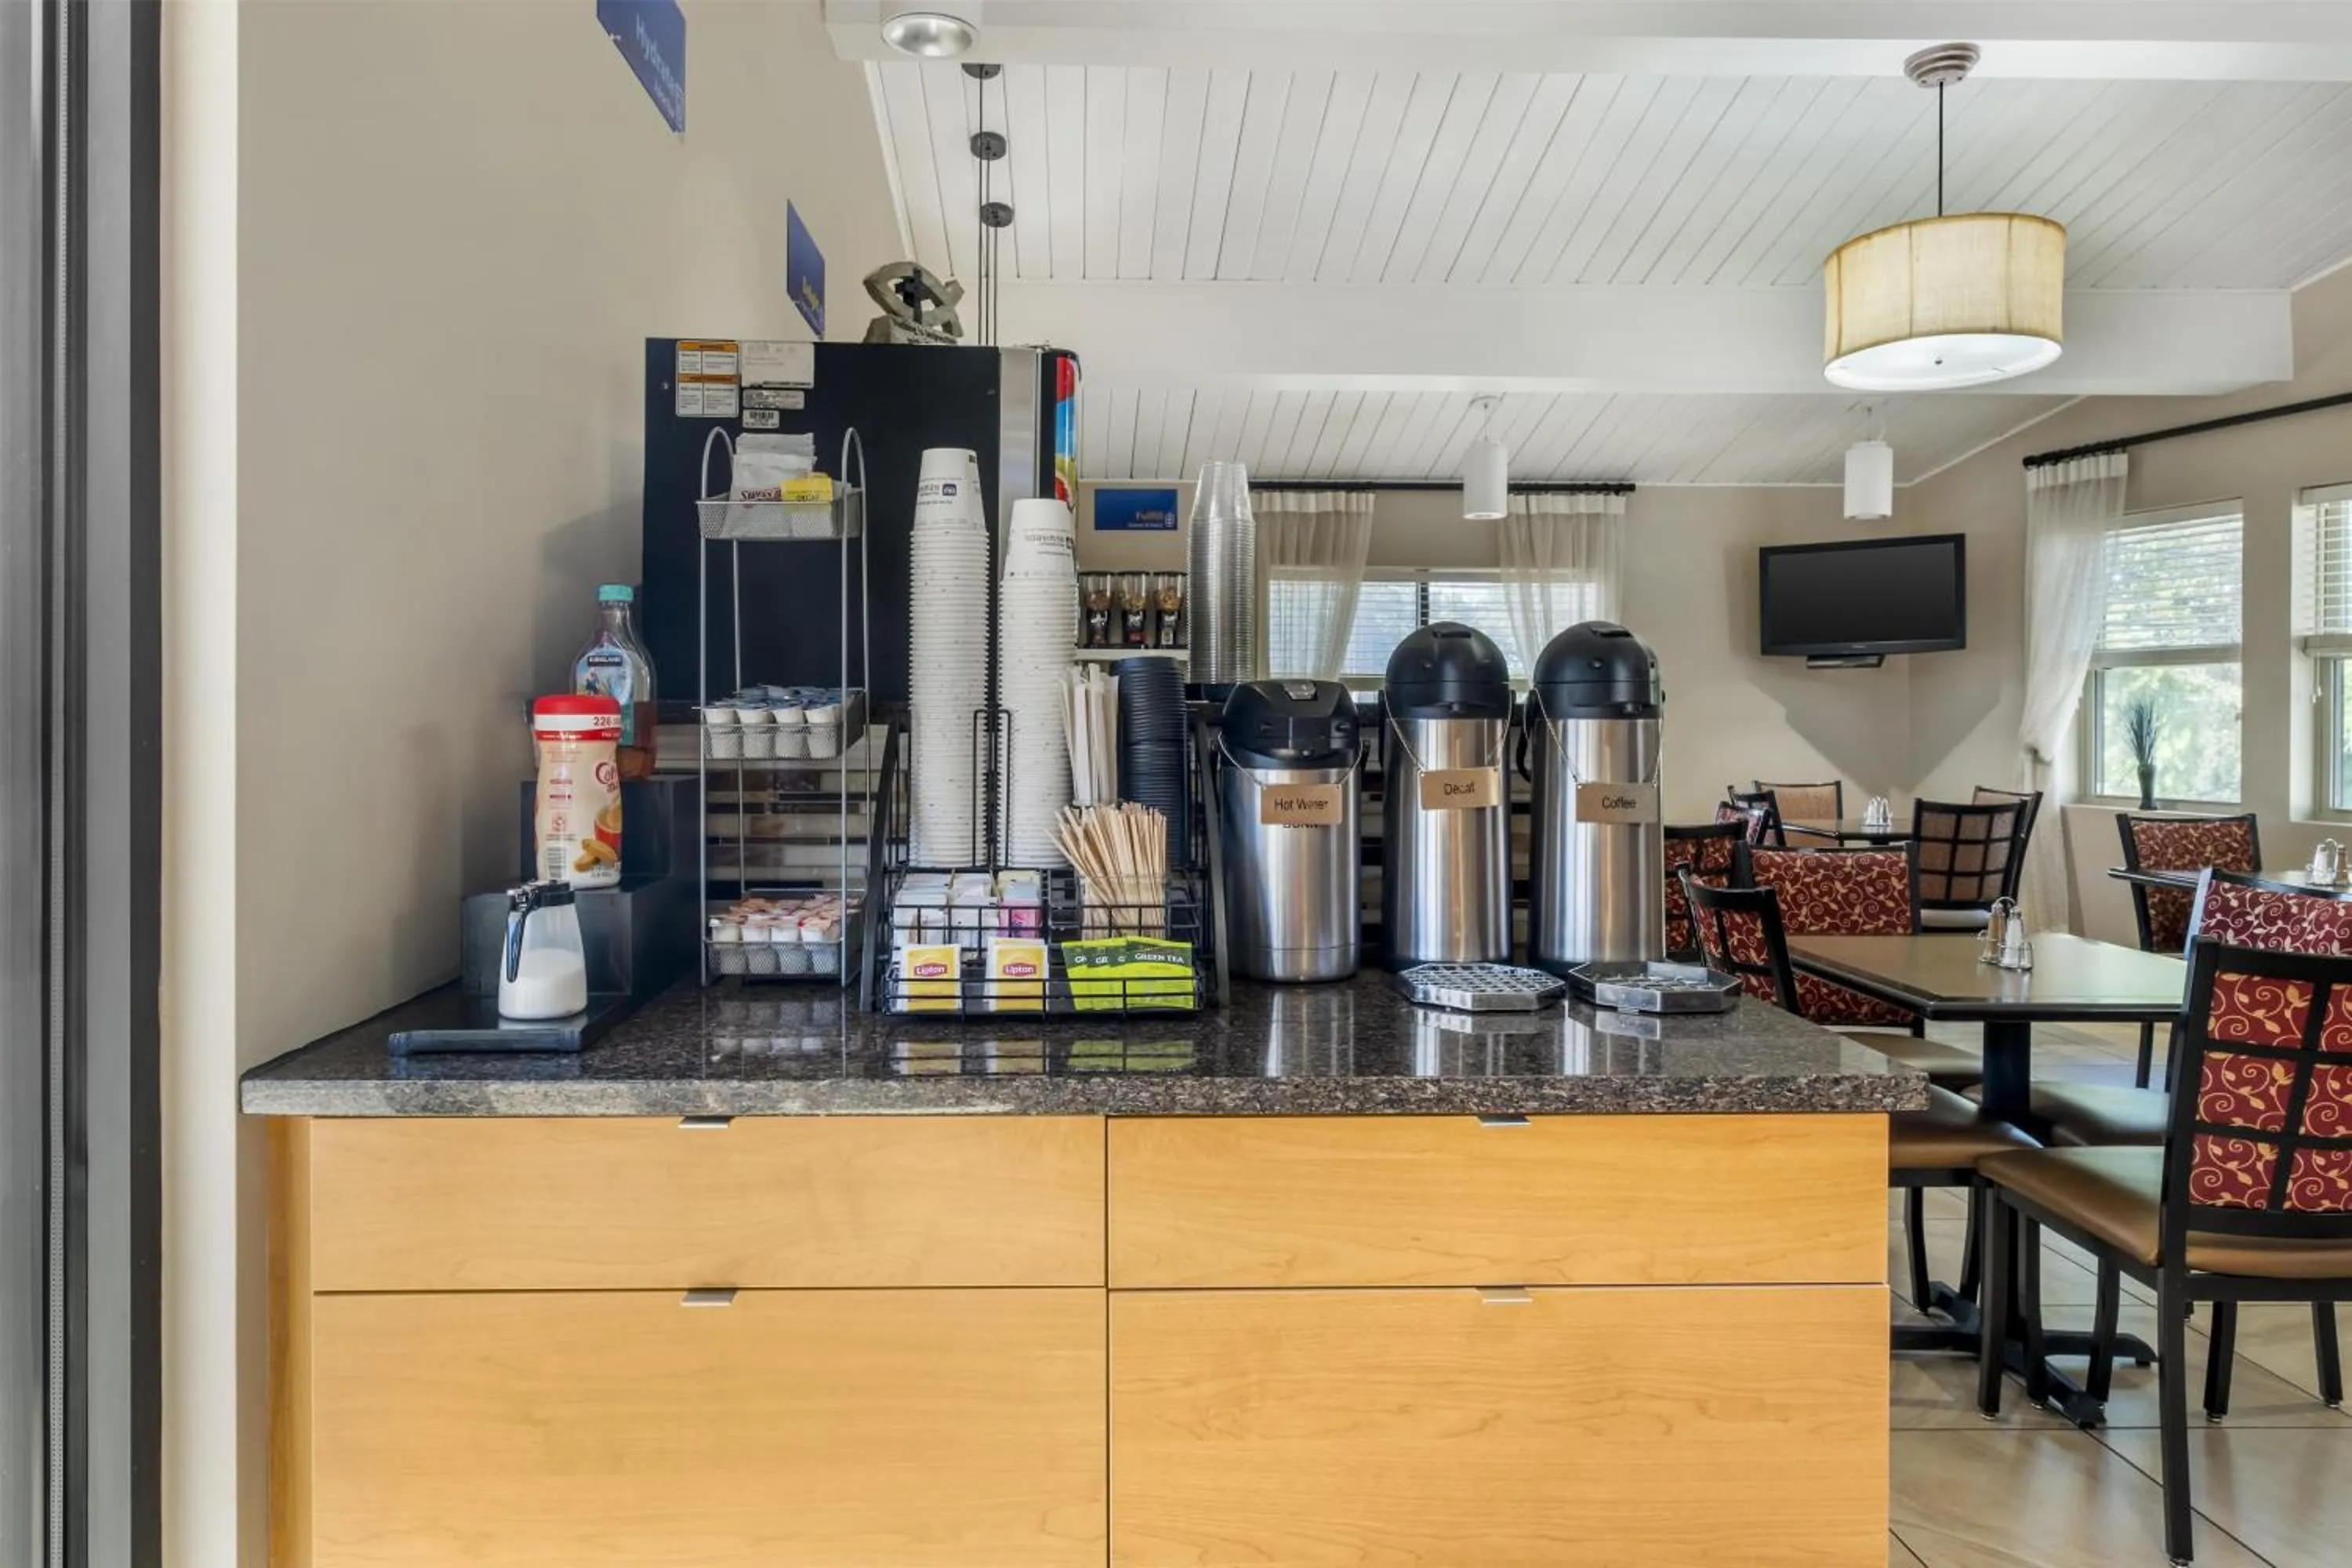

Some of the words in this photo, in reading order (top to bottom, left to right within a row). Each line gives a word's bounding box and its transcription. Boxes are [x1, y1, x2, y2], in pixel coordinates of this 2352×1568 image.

[1443, 781, 1475, 796] Decaf
[1274, 797, 1294, 811] Hot
[1296, 797, 1329, 810] Water
[1602, 795, 1637, 809] Coffee
[1134, 952, 1164, 962] GREEN
[1167, 954, 1185, 964] TEA
[916, 963, 946, 976] Lipton
[1004, 964, 1035, 976] Lipton
